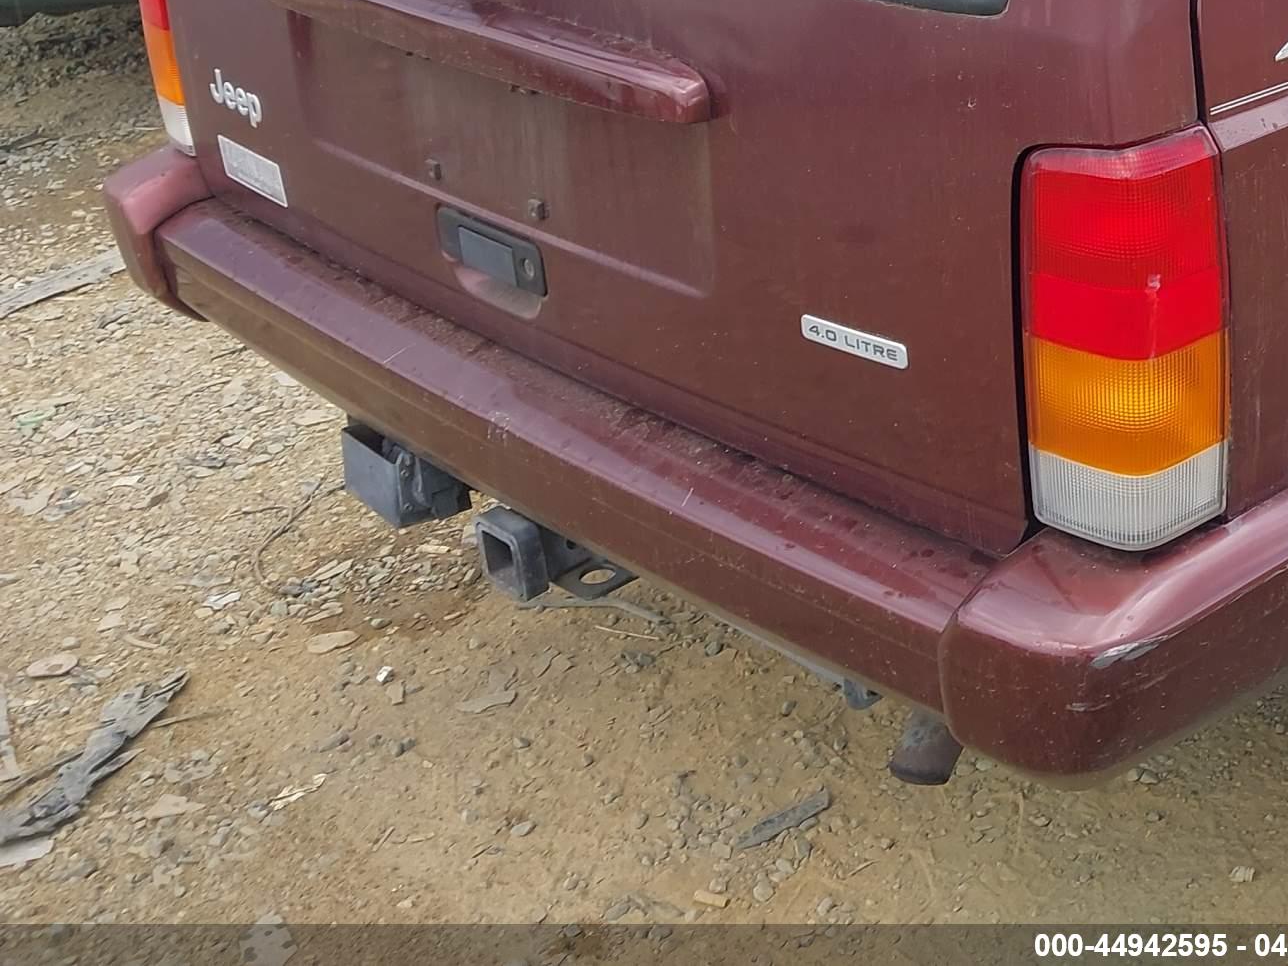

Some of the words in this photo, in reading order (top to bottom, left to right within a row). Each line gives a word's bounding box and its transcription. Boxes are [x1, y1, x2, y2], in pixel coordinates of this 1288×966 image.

[209, 68, 263, 128] Jeep
[808, 325, 837, 342] 4.0
[844, 335, 898, 361] LITRE
